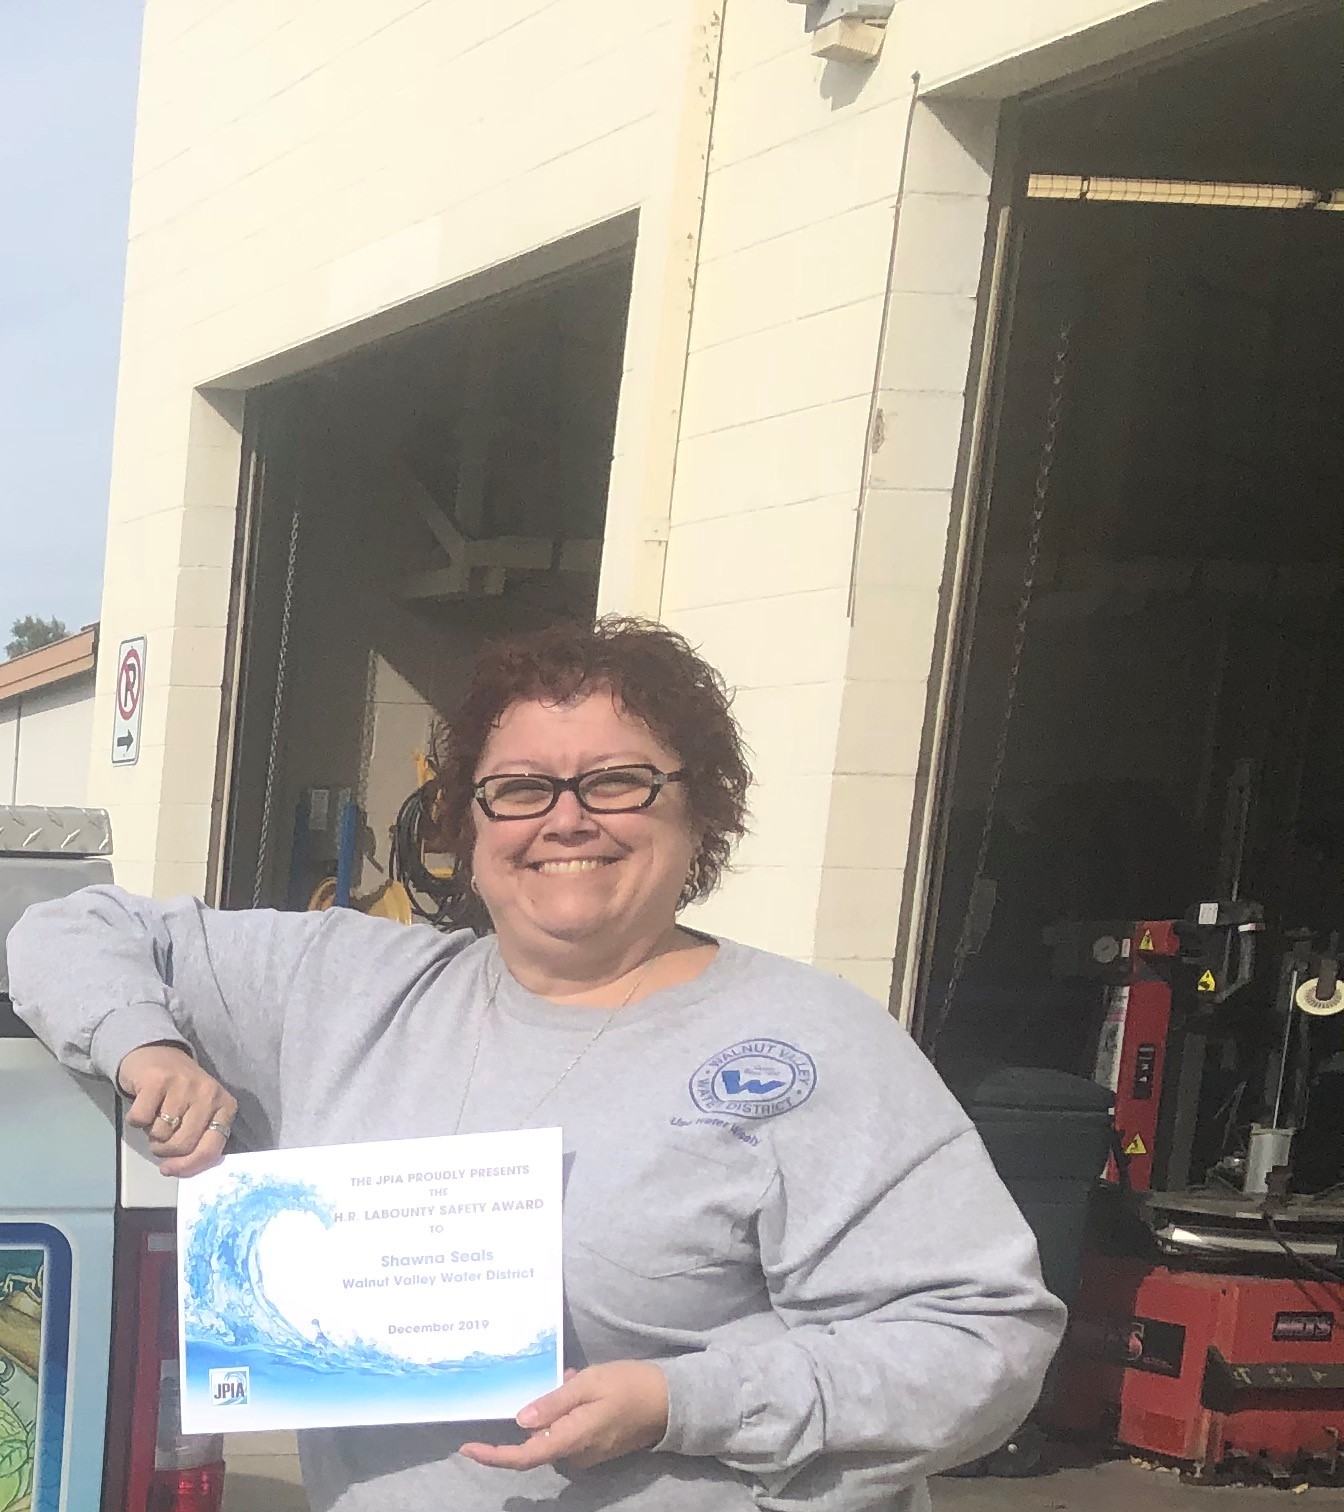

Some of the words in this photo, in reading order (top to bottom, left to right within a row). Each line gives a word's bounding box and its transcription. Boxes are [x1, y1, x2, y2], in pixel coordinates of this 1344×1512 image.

[709, 1043, 776, 1068] WALNUT
[725, 1096, 794, 1115] DISTRICT
[351, 1177, 372, 1188] THE
[376, 1174, 404, 1186] JPIA
[407, 1170, 465, 1183] PROUDLY
[470, 1165, 530, 1179] PRESENTS
[429, 1188, 448, 1197] THE
[364, 1206, 435, 1221] LABOUNTY
[440, 1202, 487, 1215] SAFETY
[491, 1199, 544, 1211] AWARD
[429, 1224, 444, 1234] TO
[381, 1253, 445, 1268] Shawna
[450, 1249, 494, 1264] Seals
[343, 1276, 390, 1290] Walnut
[394, 1274, 436, 1290] Valley
[440, 1269, 482, 1283] Water
[486, 1267, 535, 1281] District
[388, 1321, 454, 1336] December
[458, 1319, 489, 1332] 2019
[214, 1381, 246, 1400] JPIA
